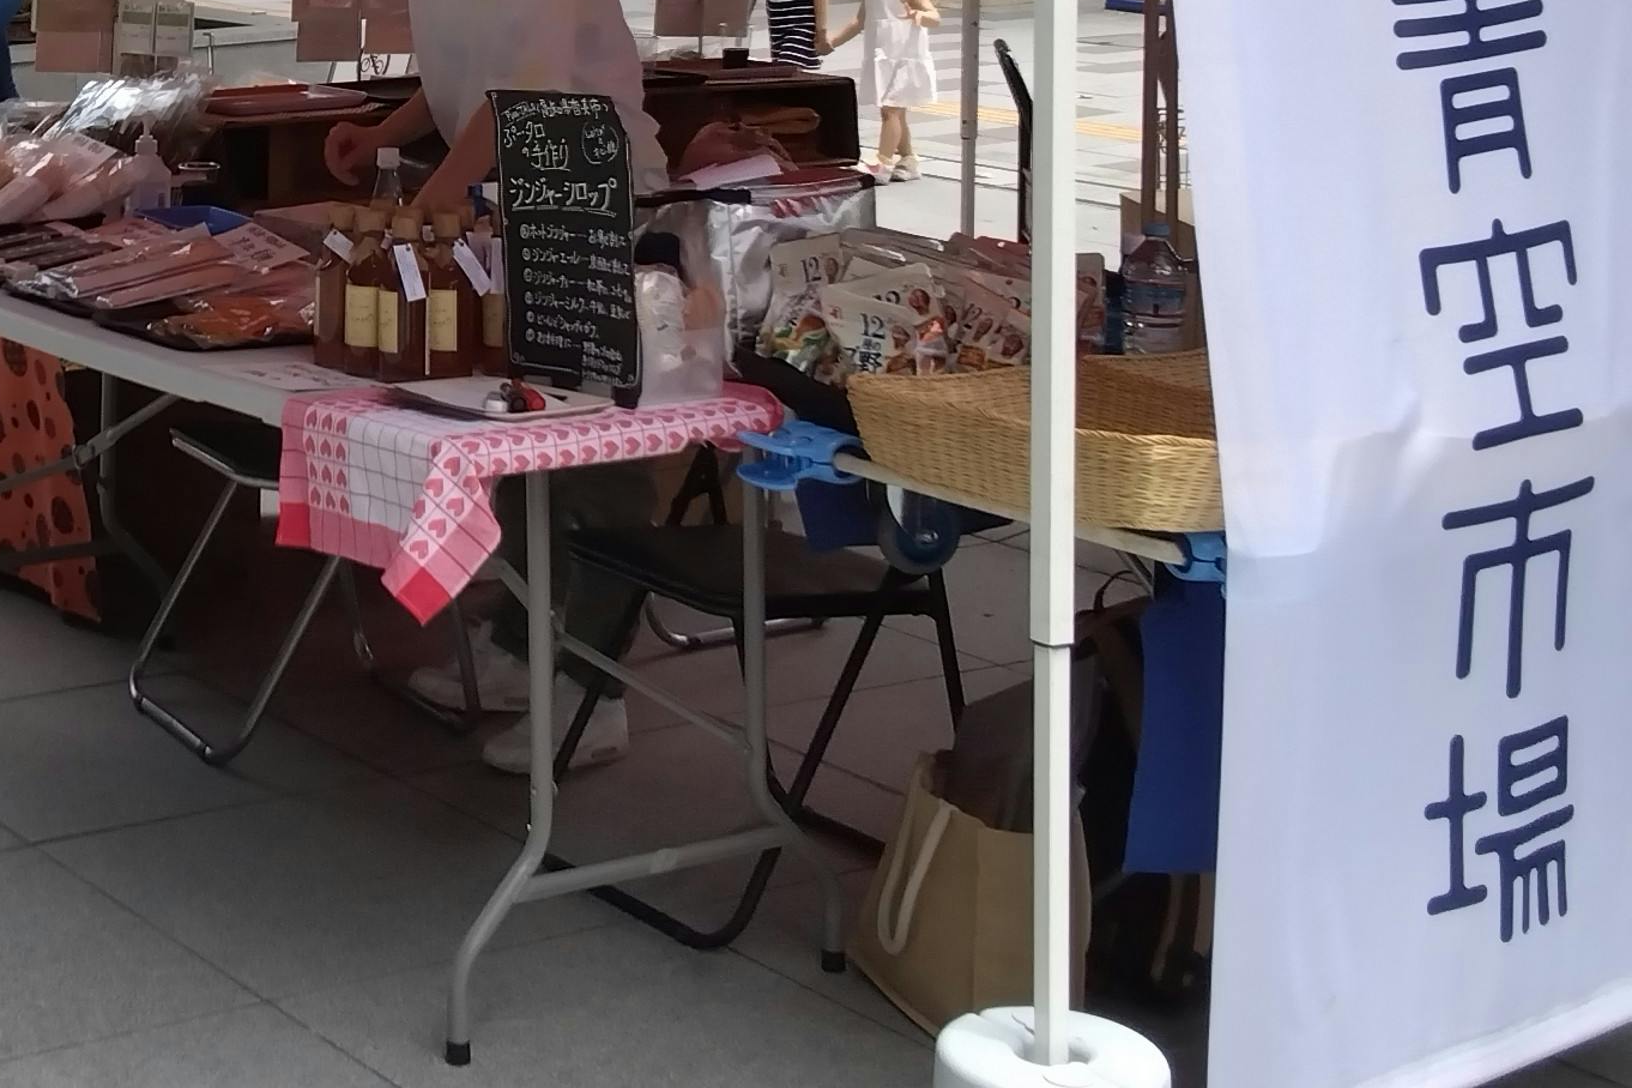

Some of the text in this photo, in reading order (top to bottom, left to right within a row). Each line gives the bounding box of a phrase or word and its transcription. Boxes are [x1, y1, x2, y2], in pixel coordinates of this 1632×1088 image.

[508, 176, 617, 211] ジンジャーシロップ
[800, 256, 822, 283] 12
[859, 312, 886, 340] 12
